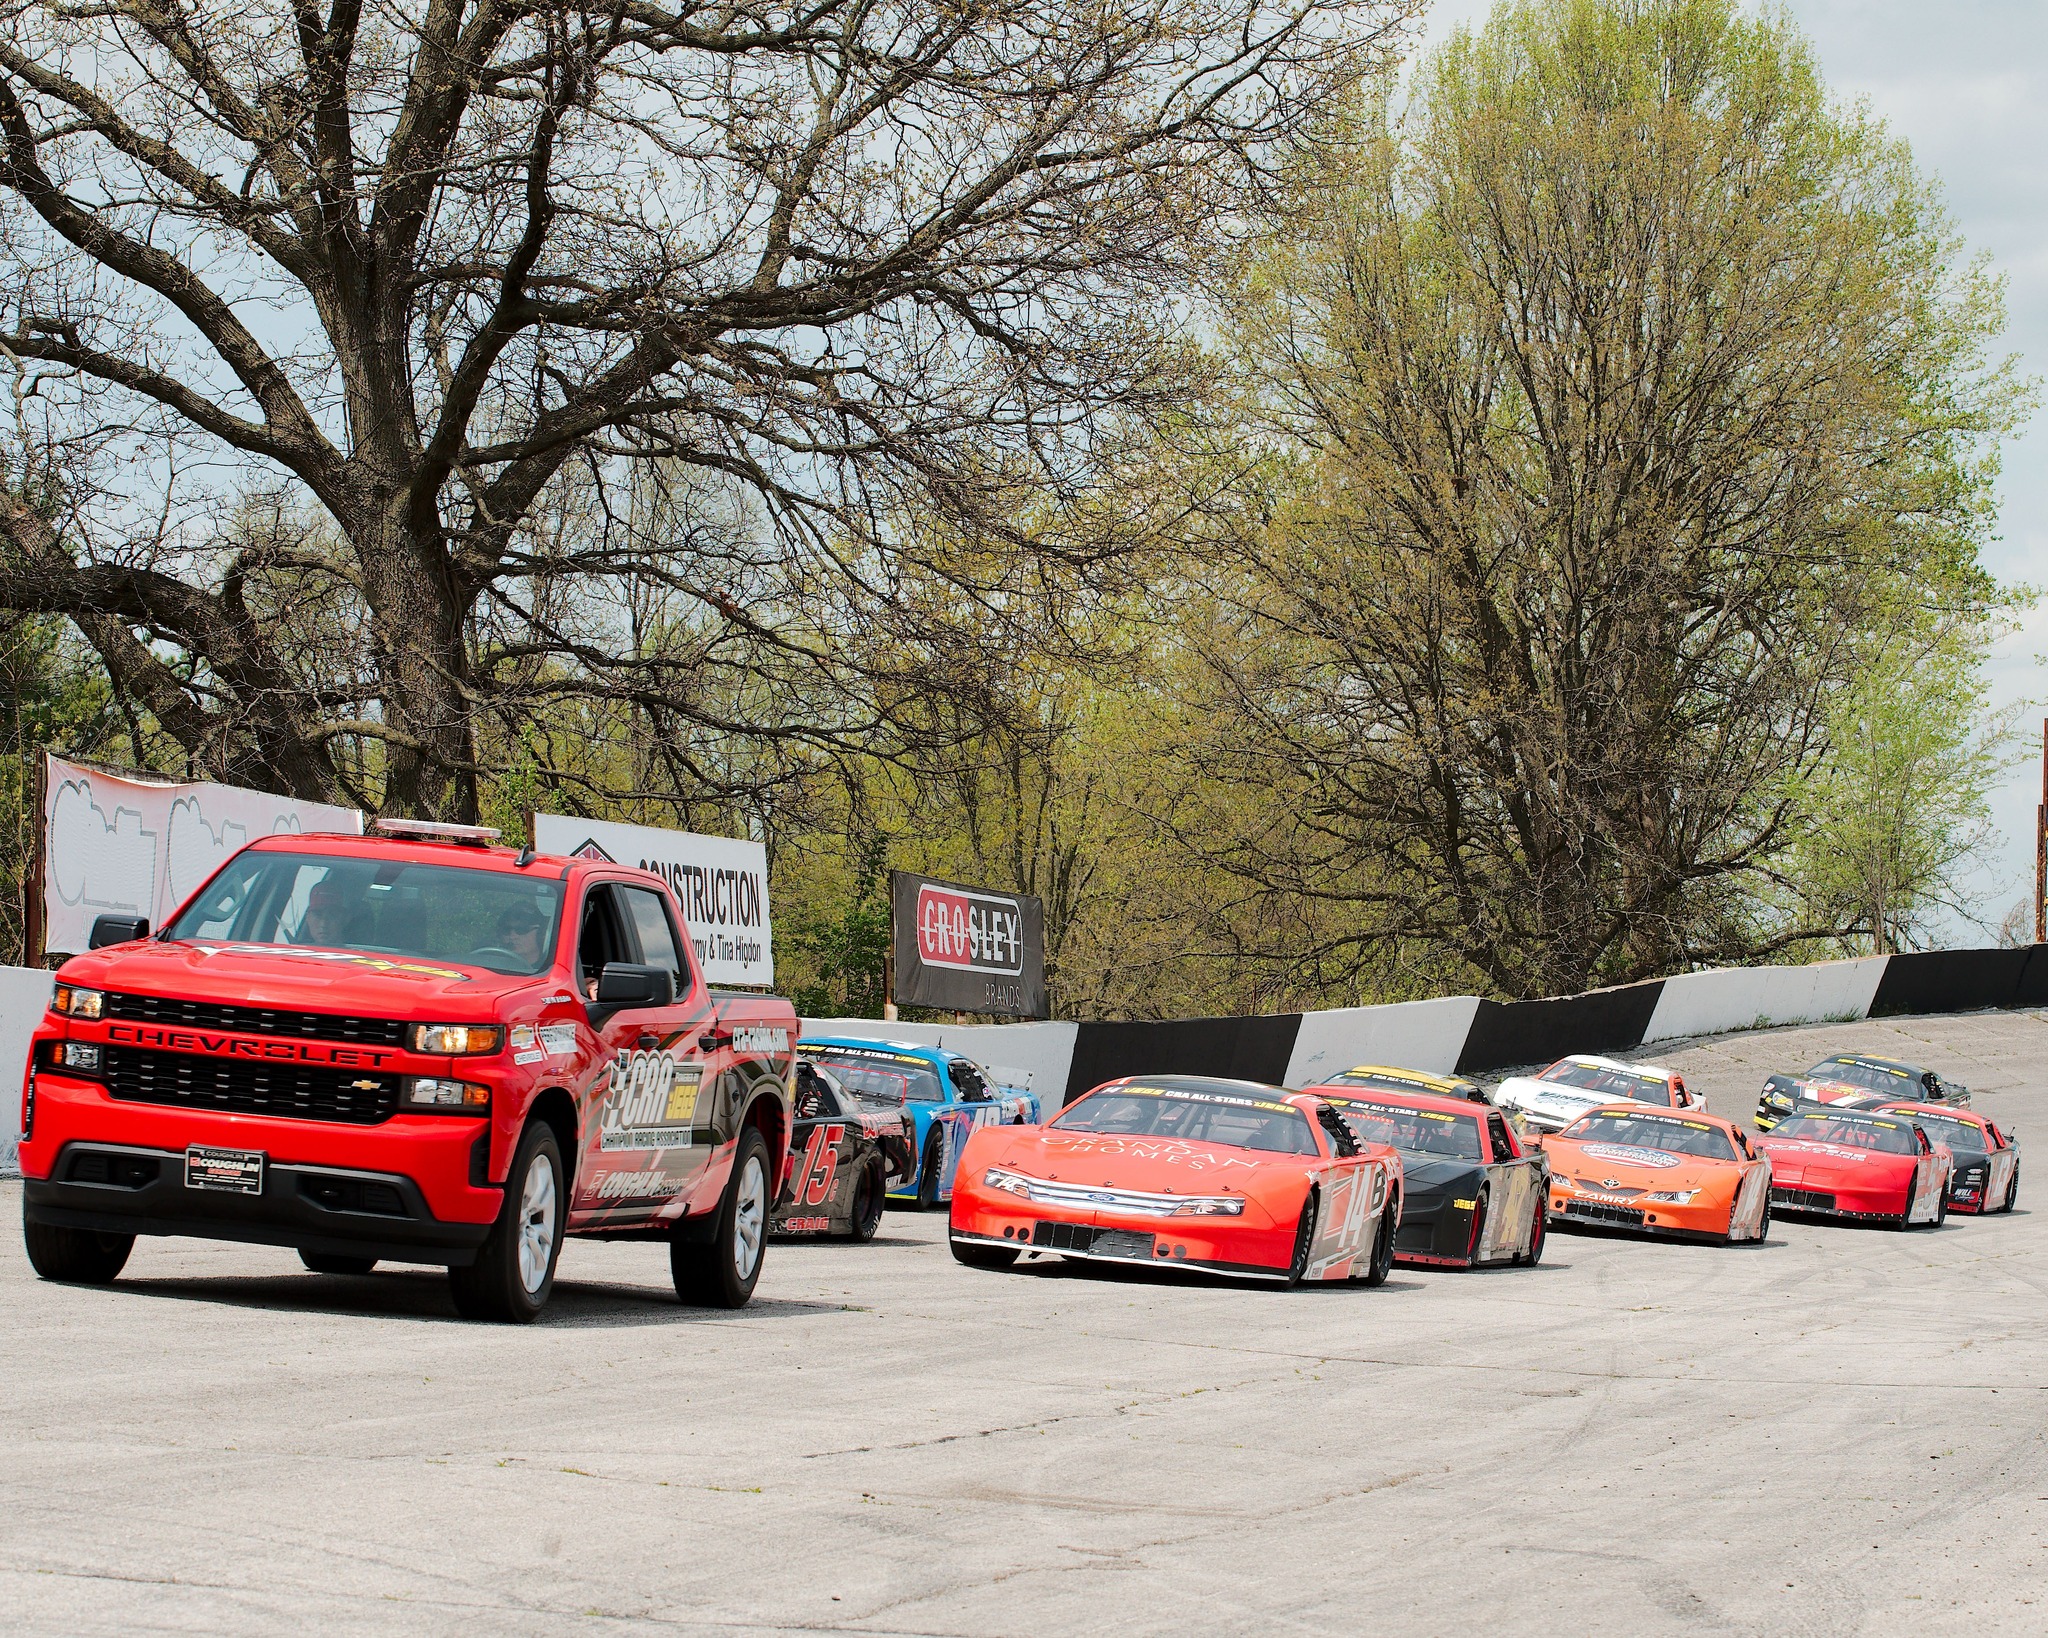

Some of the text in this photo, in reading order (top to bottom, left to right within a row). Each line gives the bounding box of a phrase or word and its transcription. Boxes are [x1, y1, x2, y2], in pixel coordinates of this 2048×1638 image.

[924, 899, 1018, 964] CROSLEY
[709, 933, 715, 960] &
[717, 933, 733, 961] Tina
[735, 934, 761, 969] Higdon
[984, 983, 1020, 1008] BRANDS
[108, 1025, 394, 1068] CHEVROLET
[845, 1049, 895, 1060] ALL-STARS
[621, 1057, 674, 1126] CRA
[1165, 1090, 1190, 1099] CRA
[1190, 1092, 1253, 1106] ALL-STARS
[1350, 1101, 1370, 1110] CRA
[1371, 1104, 1418, 1116] ALL-STARS
[602, 1130, 691, 1149] CHAMPION RACING ASSOCIATION
[200, 1158, 260, 1172] COUGHLIN
[792, 1124, 846, 1206] 15
[1040, 1137, 1262, 1168] GRANDAN
[1070, 1145, 1206, 1170] HOMES
[597, 1171, 666, 1199] COUGHLIN
[1337, 1164, 1372, 1248] 14
[1572, 1190, 1639, 1206] CAMRY
[787, 1217, 830, 1230] CRAIG
